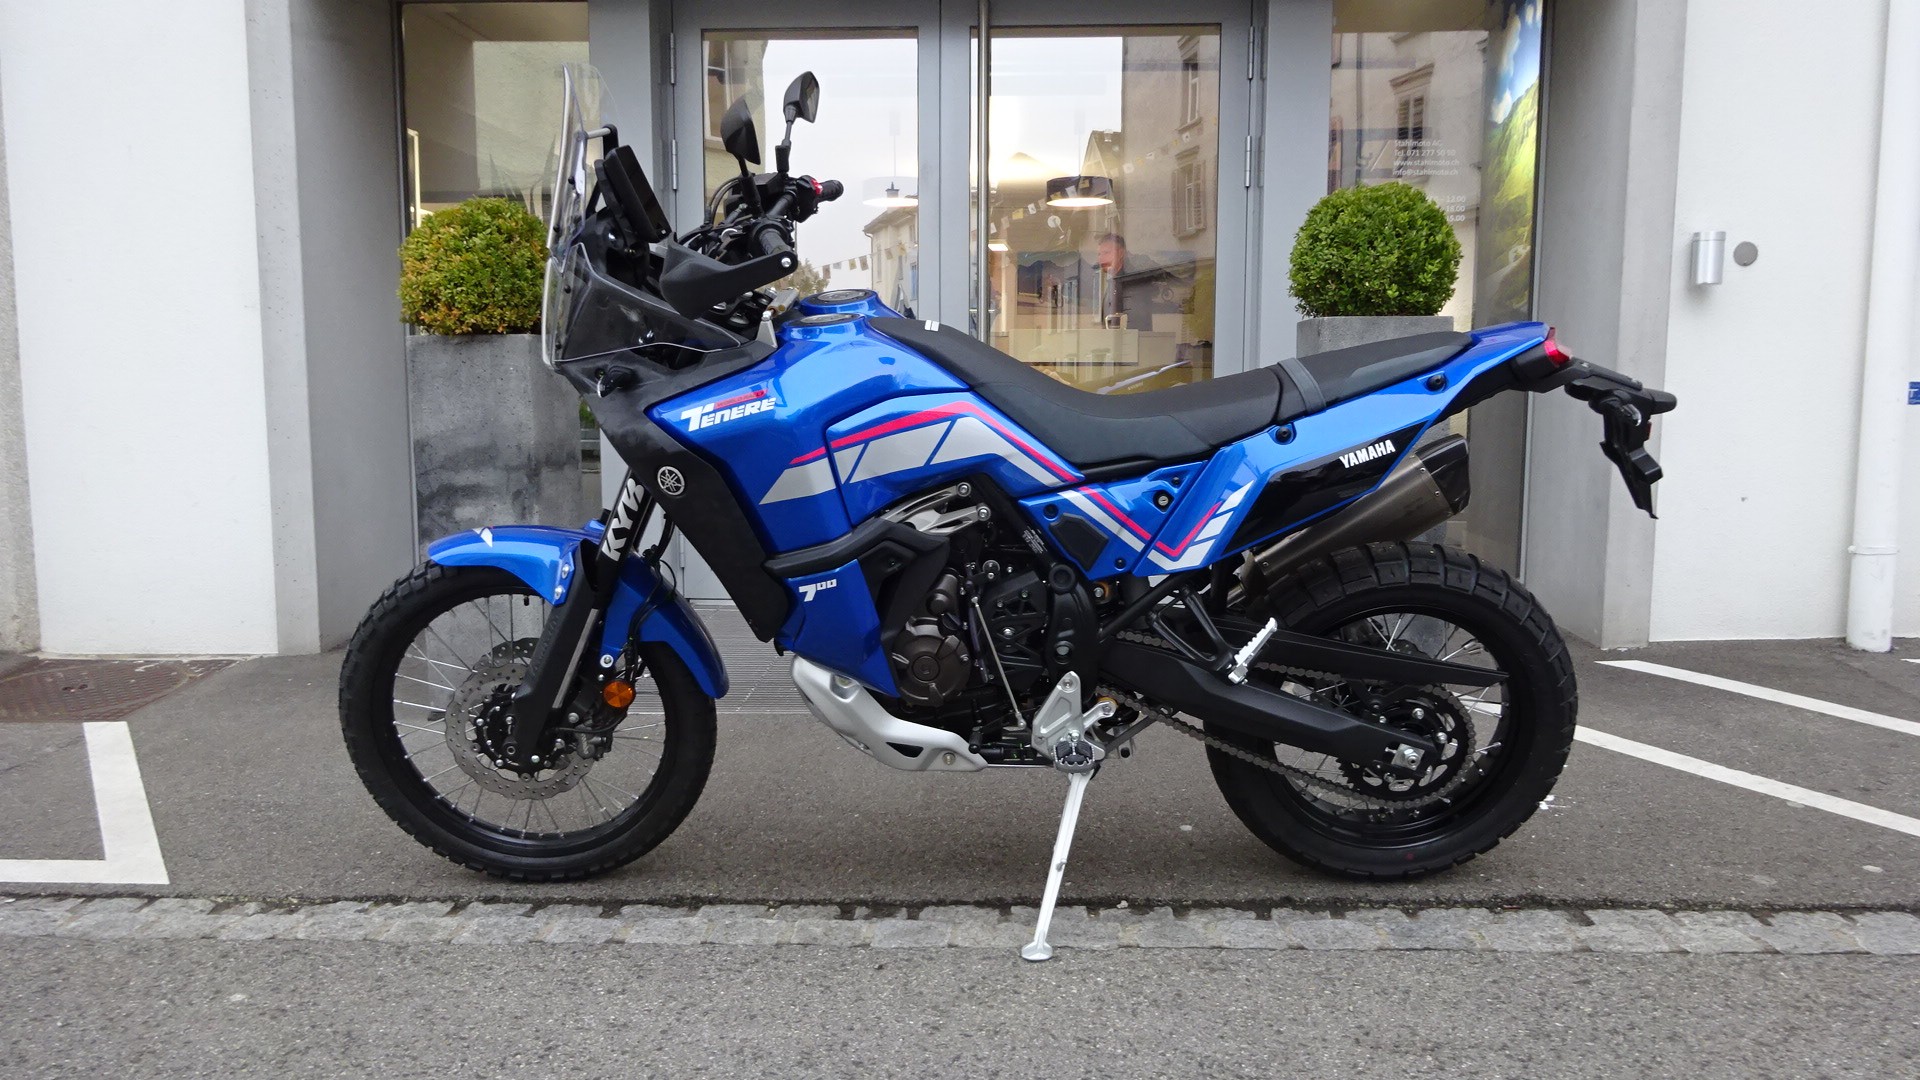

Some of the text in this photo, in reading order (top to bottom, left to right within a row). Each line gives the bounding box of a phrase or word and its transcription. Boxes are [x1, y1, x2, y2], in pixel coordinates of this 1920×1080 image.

[1406, 149, 1419, 157] 071
[1421, 149, 1435, 157] 277
[1392, 168, 1459, 176] info@stahlmoto.ch
[1339, 439, 1396, 469] YAMAHA
[601, 477, 645, 562] KYB
[799, 579, 837, 602] 700
